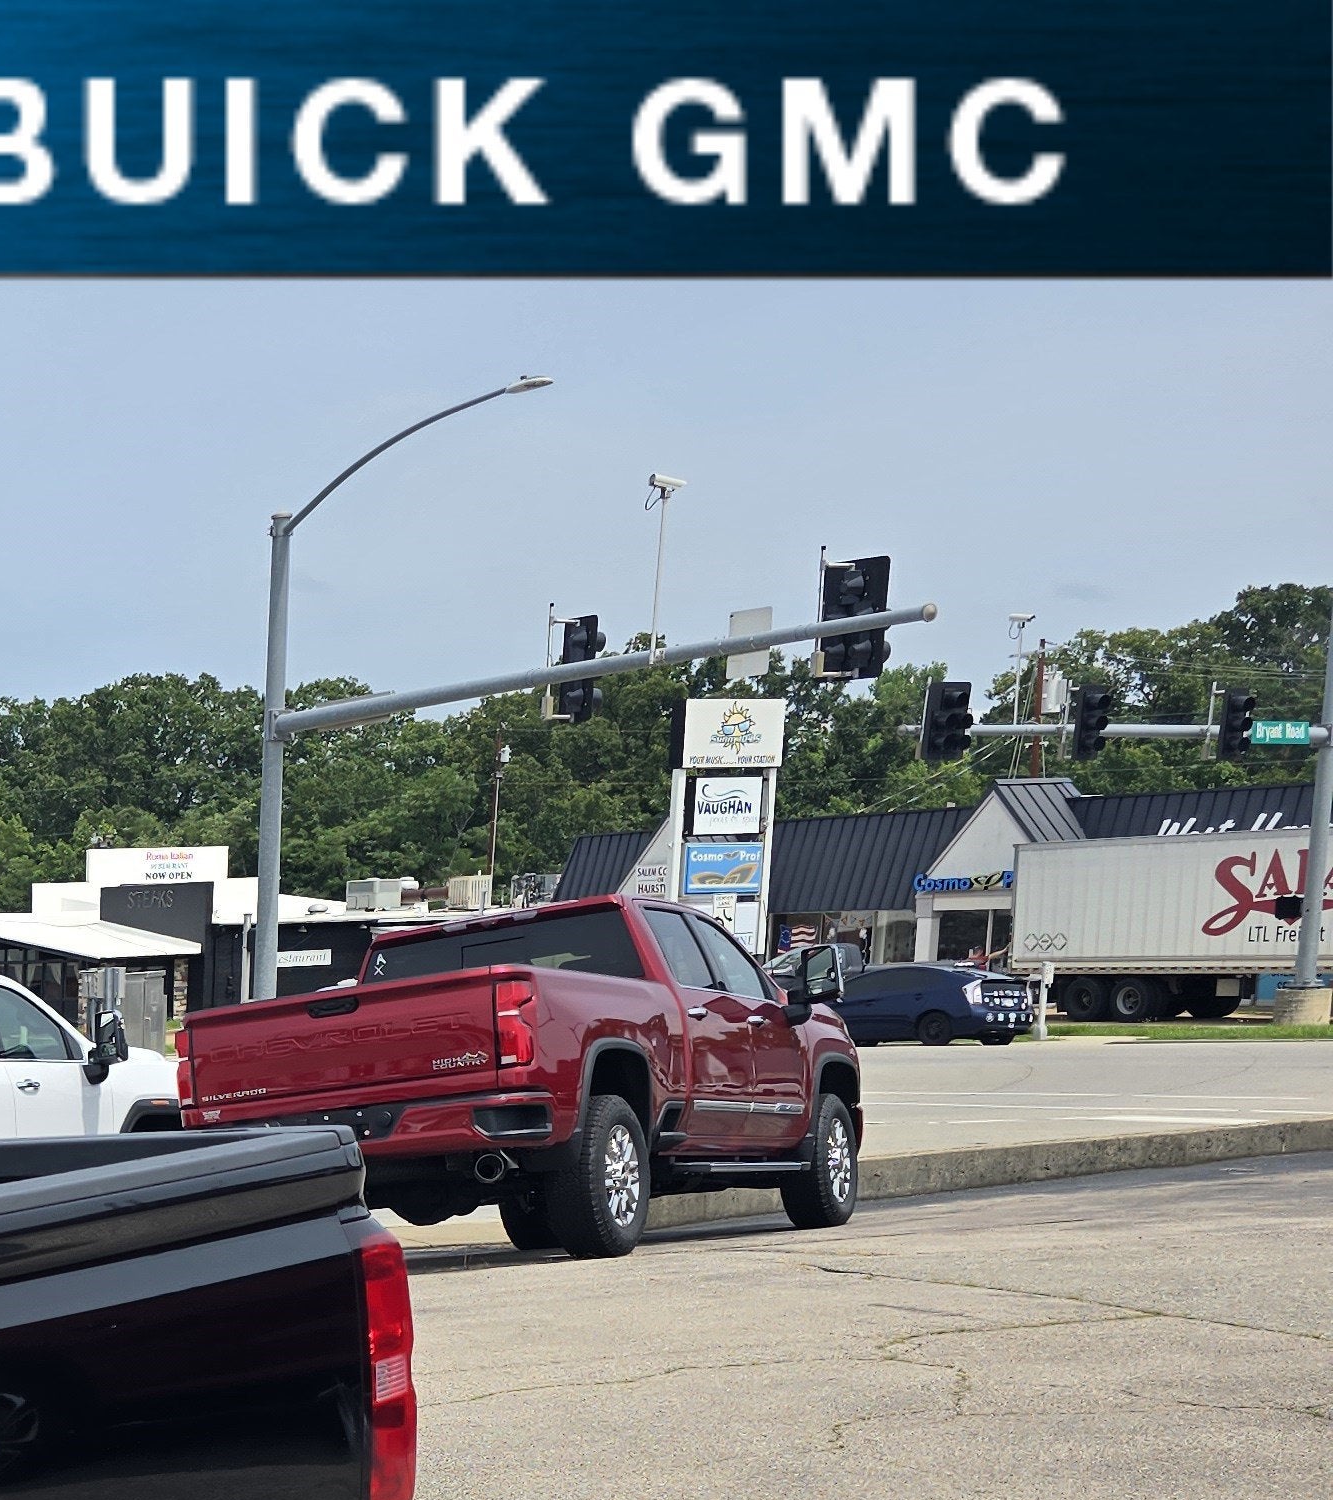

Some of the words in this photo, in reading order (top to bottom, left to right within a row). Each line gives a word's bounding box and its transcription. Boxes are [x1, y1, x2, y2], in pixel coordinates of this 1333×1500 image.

[1256, 722, 1283, 743] Bryant
[1285, 723, 1306, 739] Road
[697, 800, 752, 815] VAUGHAN
[690, 851, 724, 862] Cosmo
[739, 850, 761, 861] Prof
[168, 872, 193, 880] OPEN
[912, 872, 973, 892] Cosmo
[1247, 926, 1270, 943] LTL
[1275, 926, 1326, 943] Freit
[201, 1087, 267, 1102] SILVERADO
